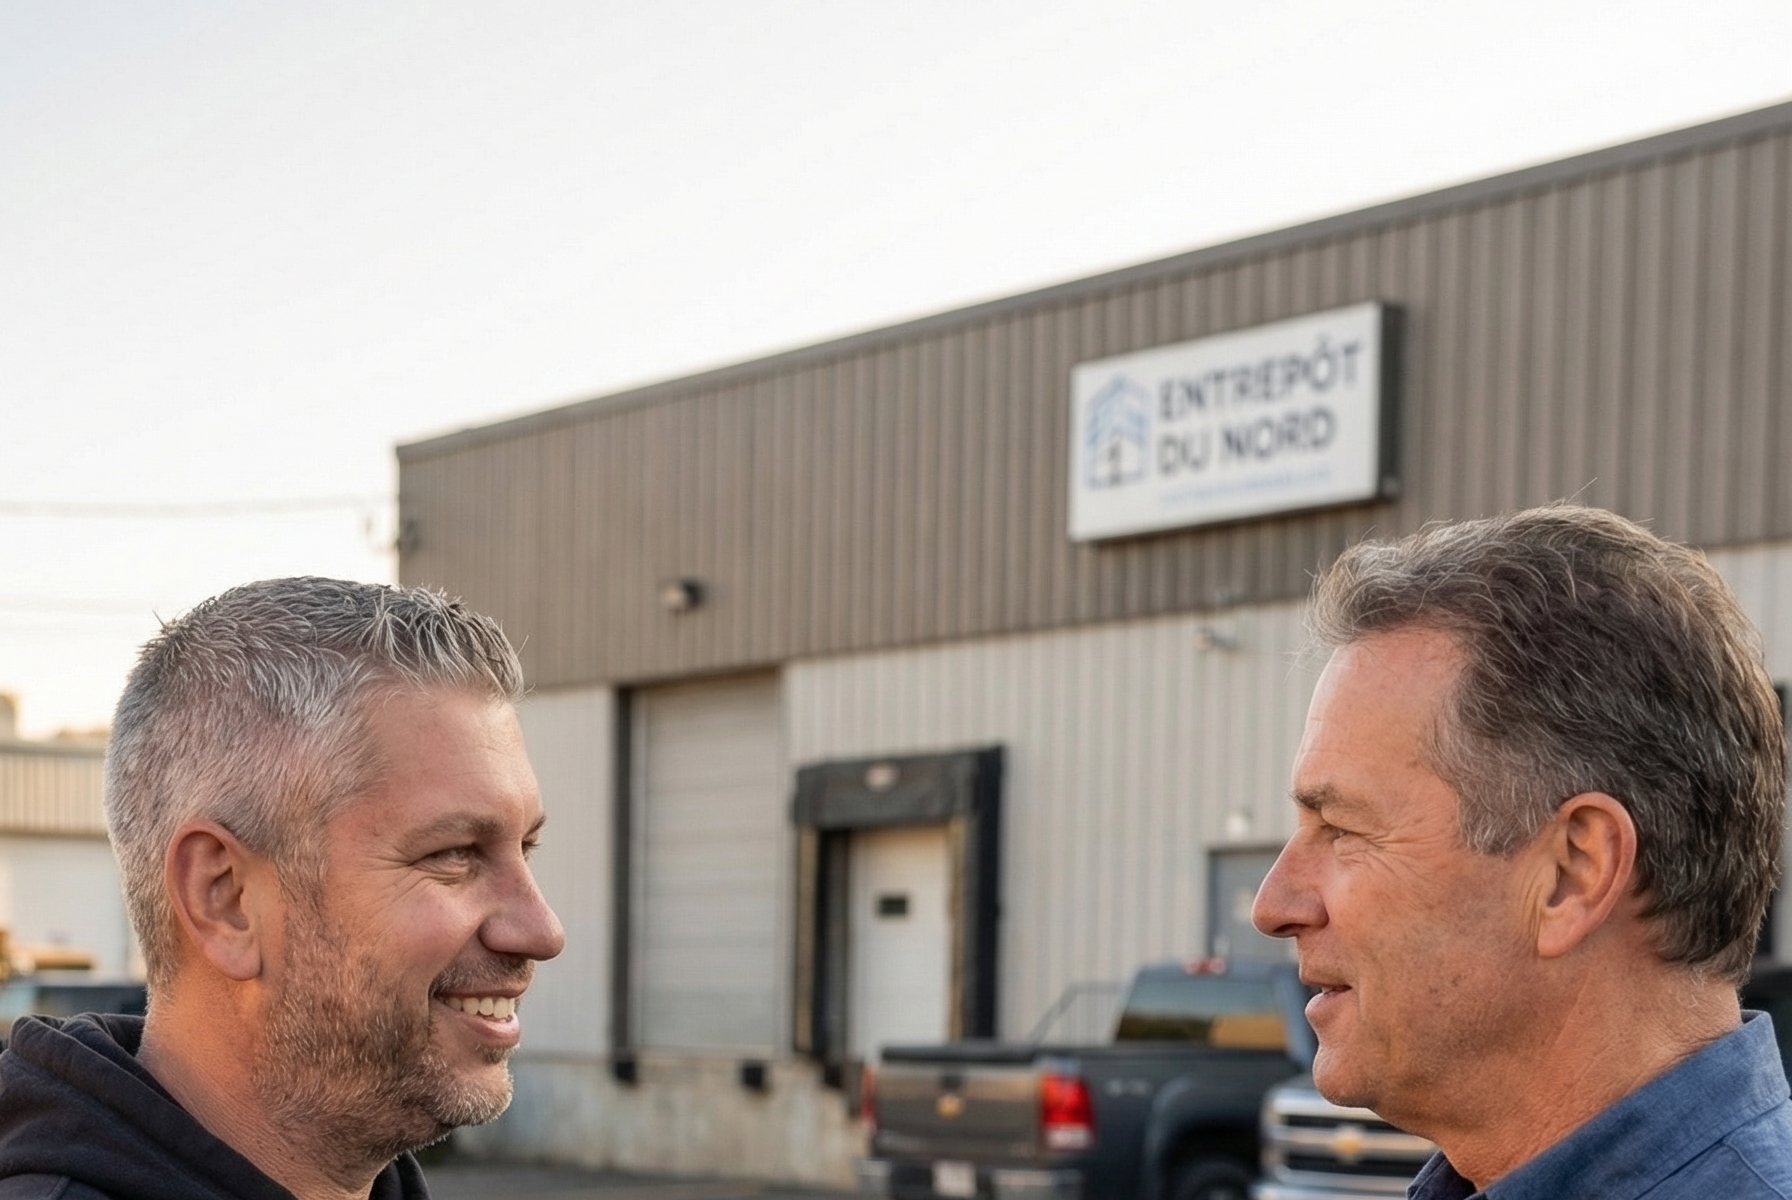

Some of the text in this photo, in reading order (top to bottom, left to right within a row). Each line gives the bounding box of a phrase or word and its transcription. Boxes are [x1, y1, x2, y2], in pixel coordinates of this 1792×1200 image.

[1160, 335, 1359, 421] ENTREPÔT
[1160, 407, 1337, 475] DU NORD
